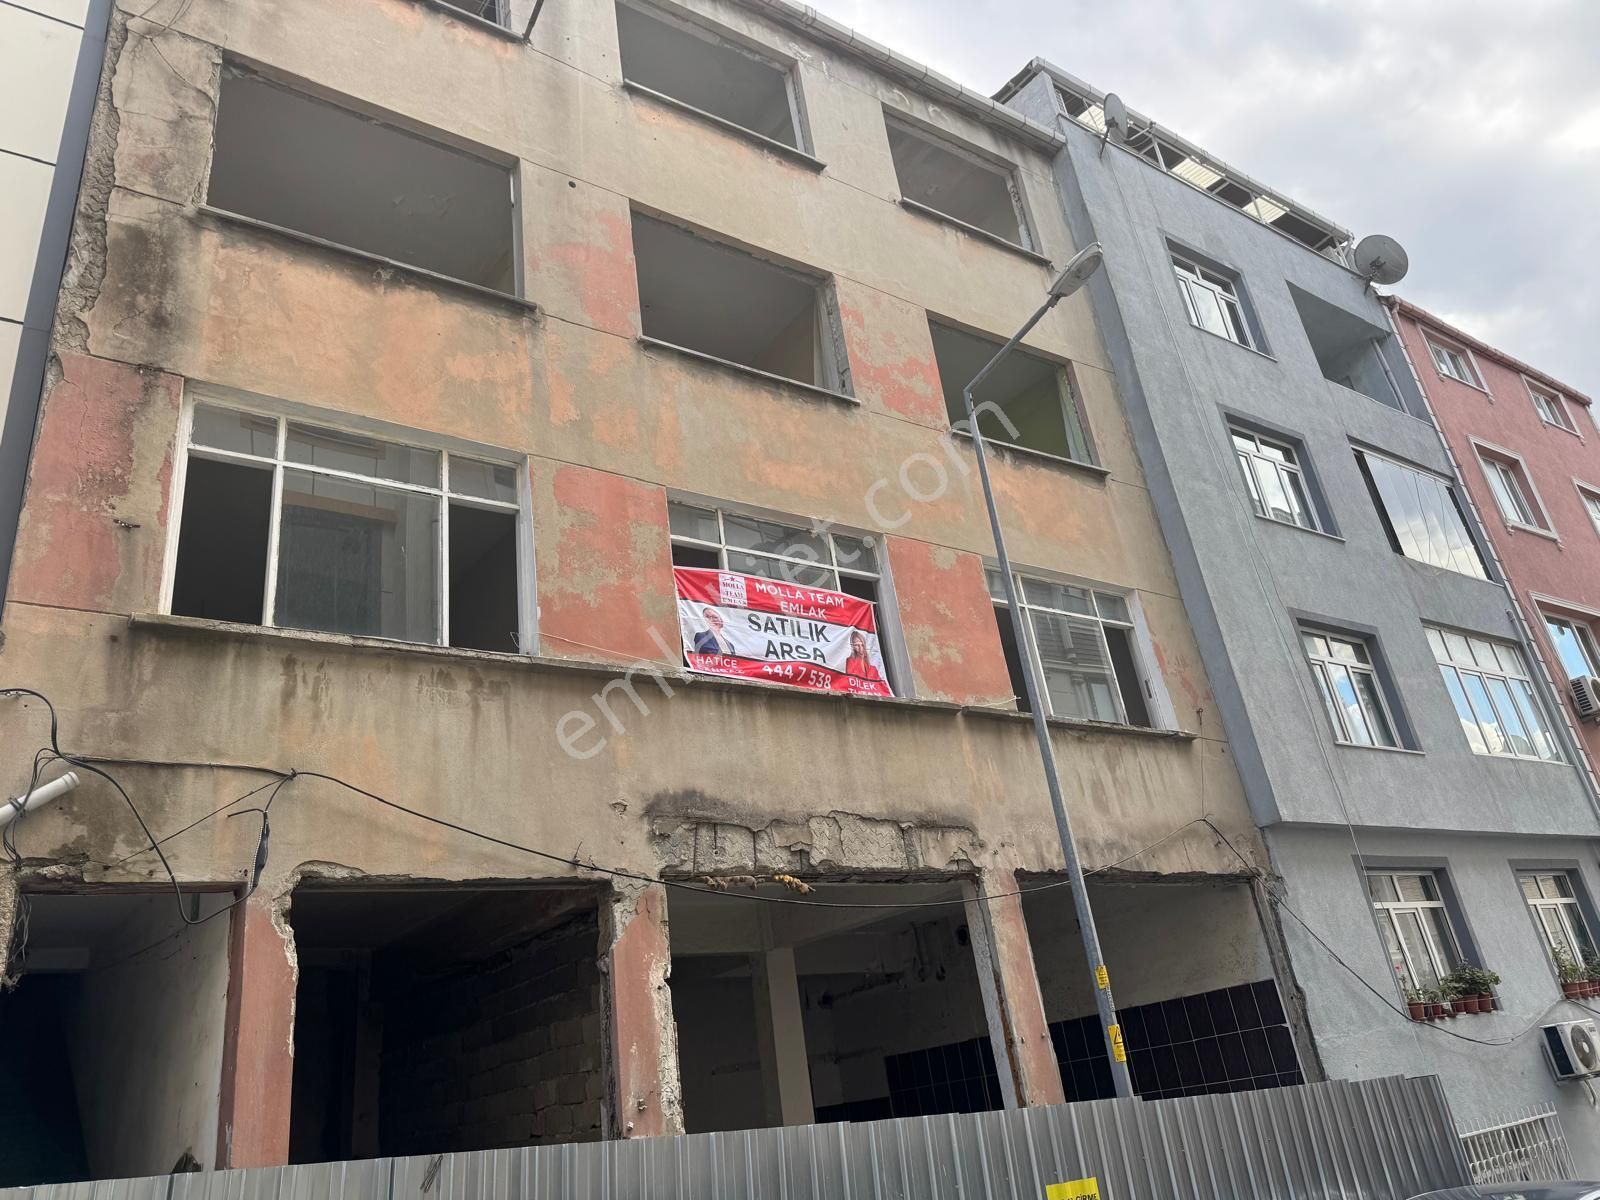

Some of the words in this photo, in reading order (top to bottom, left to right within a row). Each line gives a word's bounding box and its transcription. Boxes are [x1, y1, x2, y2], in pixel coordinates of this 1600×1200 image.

[755, 582, 803, 600] MOLLA
[808, 592, 844, 608] TEAM
[780, 601, 826, 619] EMLAK
[747, 613, 830, 643] SATILIK
[696, 656, 738, 669] HATİCE
[765, 640, 826, 663] ARSA
[761, 664, 793, 680] 444
[797, 667, 804, 681] 7
[808, 672, 832, 689] 538
[849, 678, 877, 691] DİLEK
